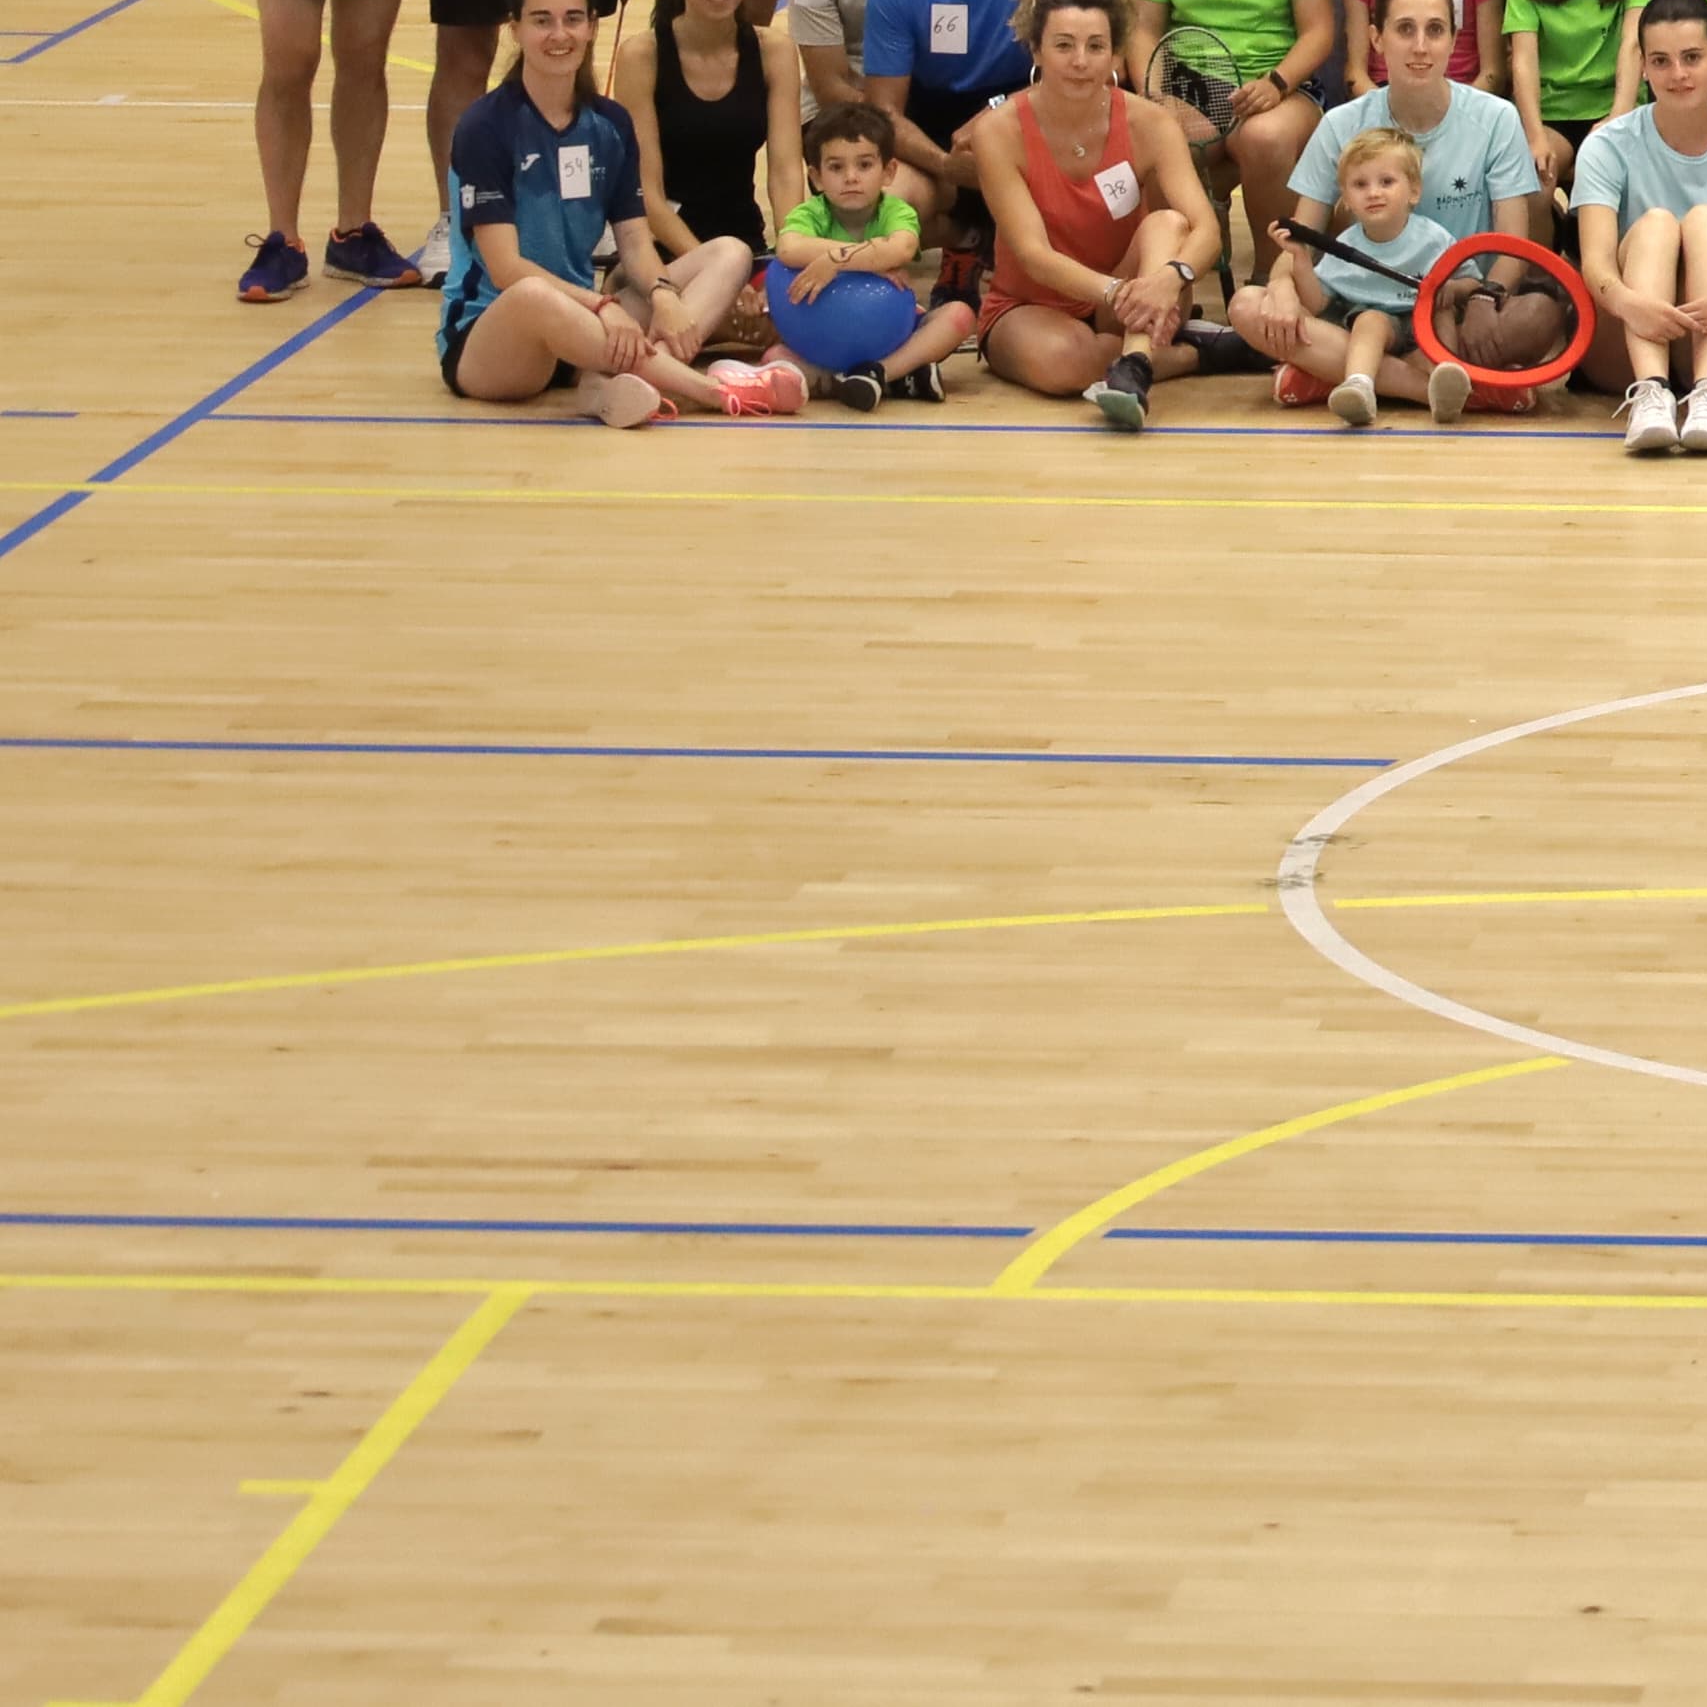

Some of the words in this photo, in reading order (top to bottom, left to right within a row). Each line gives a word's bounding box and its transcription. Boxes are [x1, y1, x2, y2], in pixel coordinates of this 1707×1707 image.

[934, 15, 960, 35] 66
[564, 156, 585, 178] 54
[1104, 180, 1128, 200] 78
